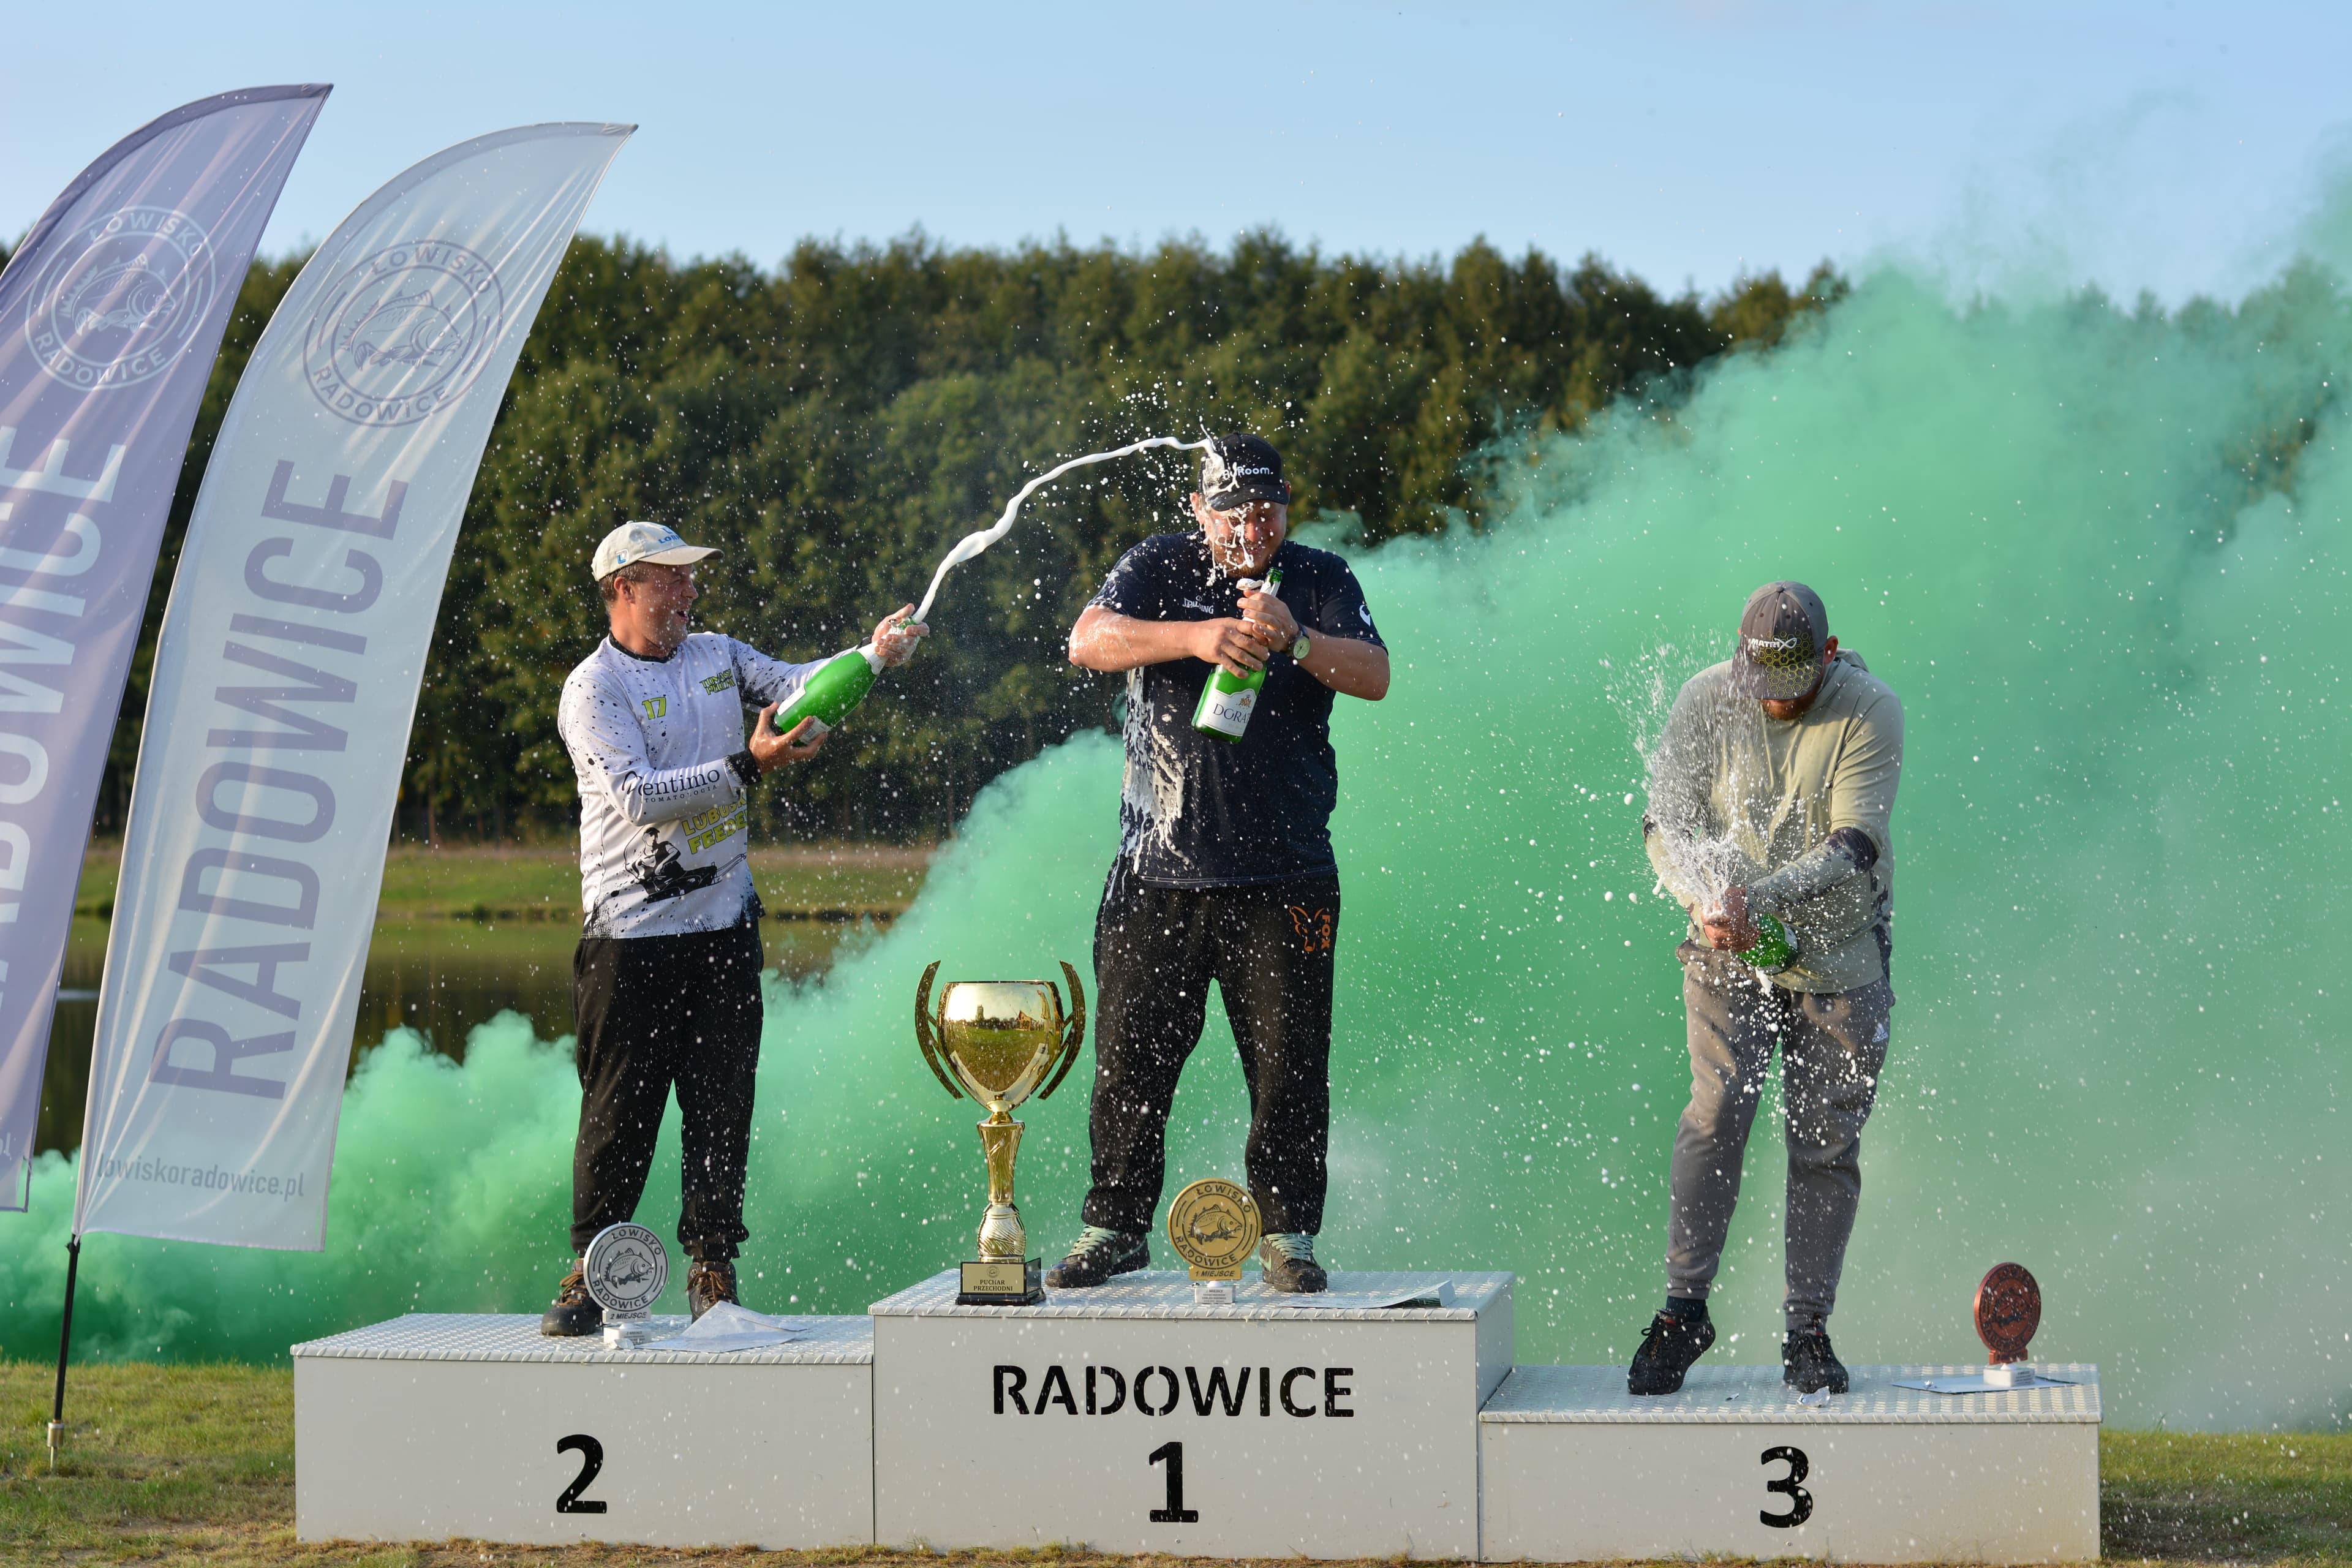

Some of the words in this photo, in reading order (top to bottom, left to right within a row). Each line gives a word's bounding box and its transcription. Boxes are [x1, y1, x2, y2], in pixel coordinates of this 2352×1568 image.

[371, 246, 491, 294] ŁOWISKO
[34, 331, 166, 384] RADOWICE
[313, 365, 450, 421] RADOWICE
[1751, 638, 1797, 651] MATRIX
[642, 696, 667, 720] 17
[149, 459, 410, 1100] RADOWICE
[687, 809, 748, 855] FEEDE
[1321, 914, 1330, 949] FOX
[97, 1153, 304, 1202] lowiskoradowice.pl
[611, 1228, 662, 1256] ŁOWISKO
[1175, 1235, 1237, 1267] RADOWICE
[592, 1280, 649, 1309] RADOWICE
[992, 1365, 1355, 1418] RADOWICE
[556, 1434, 608, 1513] 2
[1148, 1441, 1199, 1523] 1
[1759, 1446, 1814, 1529] 3
